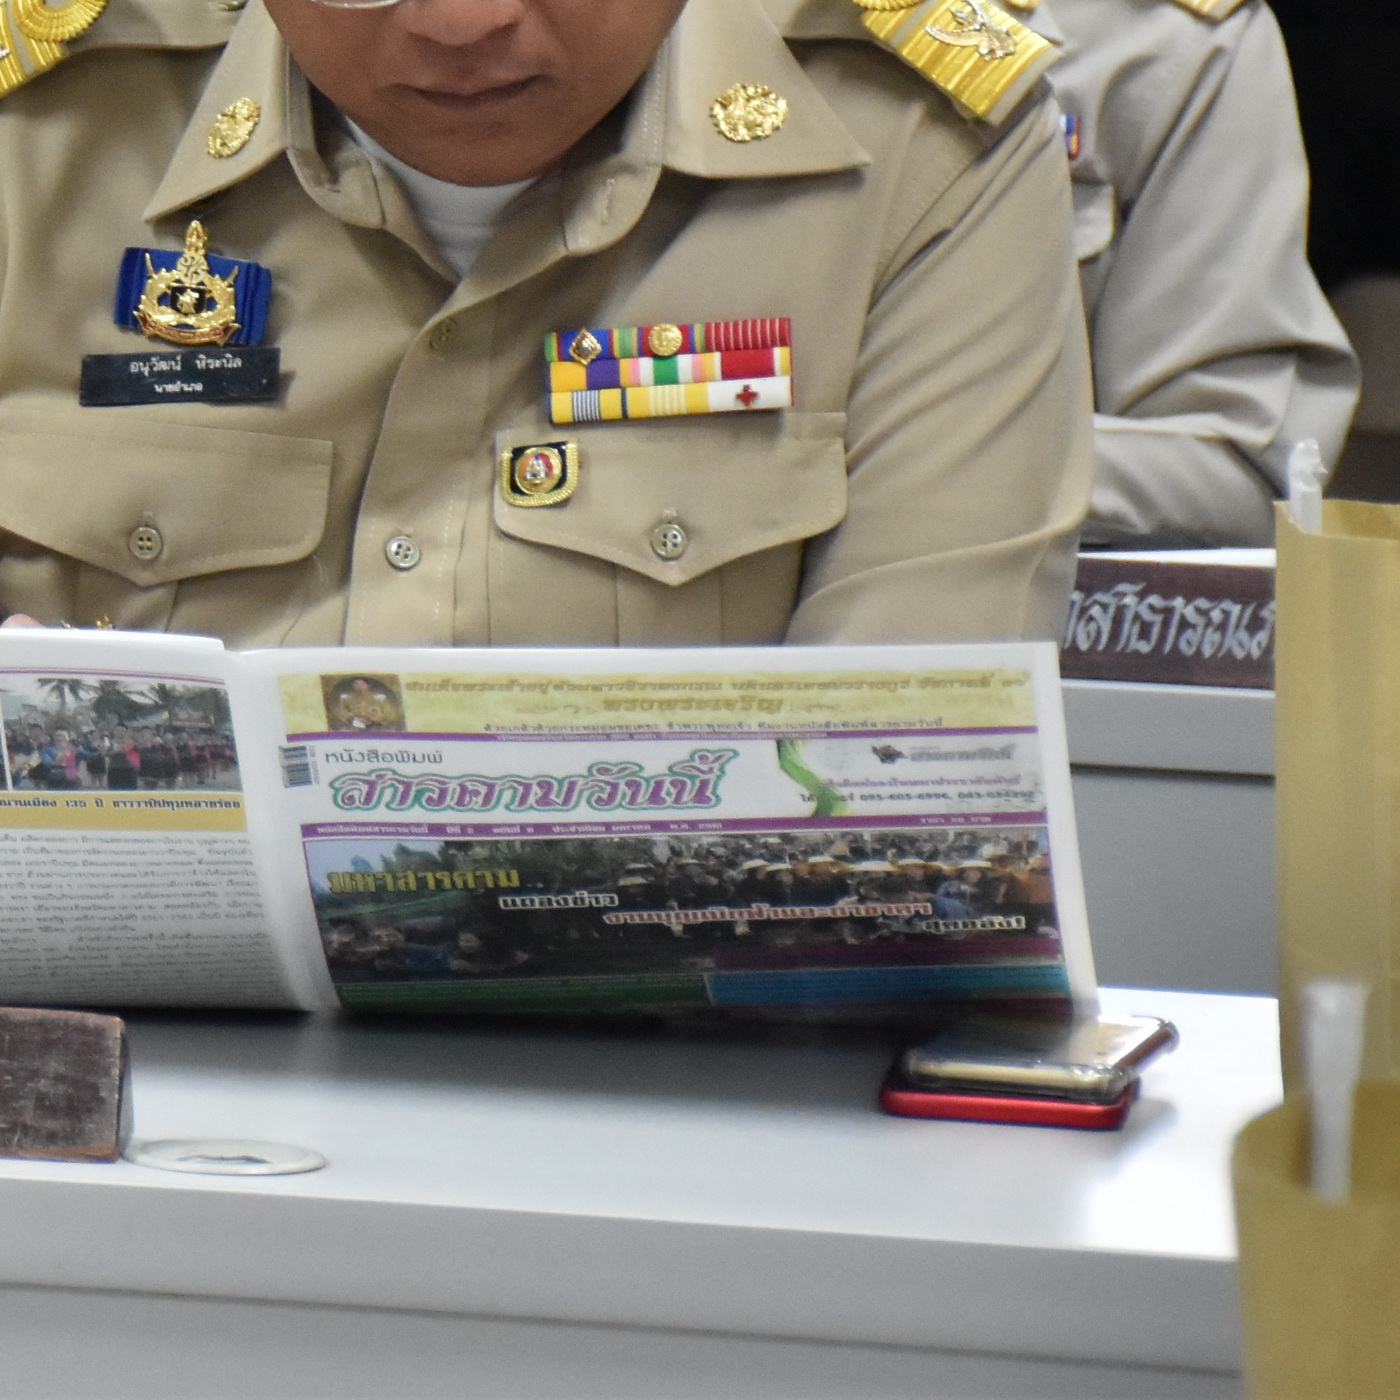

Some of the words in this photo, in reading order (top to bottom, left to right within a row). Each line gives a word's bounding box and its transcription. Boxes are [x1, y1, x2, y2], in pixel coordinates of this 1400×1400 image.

[324, 747, 444, 765] หนังสือพิมพ์
[331, 748, 739, 813] สารคามวันนี้
